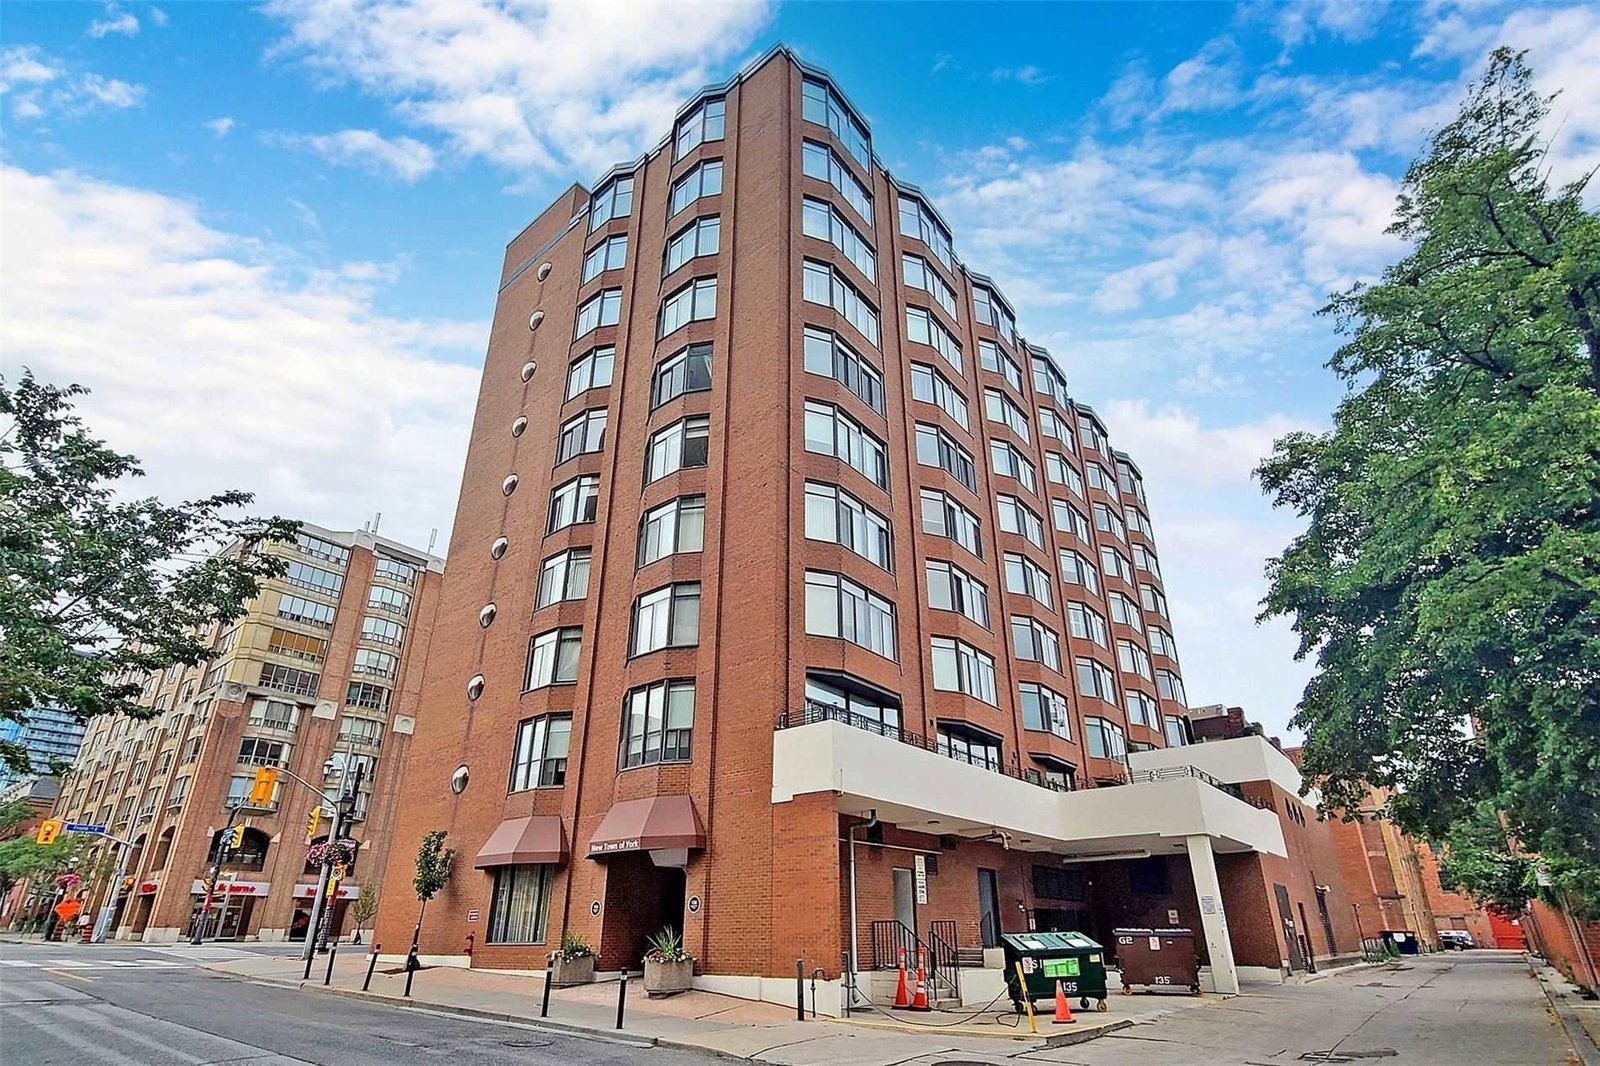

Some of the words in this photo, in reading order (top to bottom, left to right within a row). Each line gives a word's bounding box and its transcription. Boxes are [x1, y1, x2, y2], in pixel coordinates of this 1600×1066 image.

[591, 843, 603, 852] New
[604, 842, 618, 851] Town
[619, 840, 625, 849] of
[626, 839, 640, 848] York
[1118, 936, 1134, 945] G2
[1155, 976, 1171, 985] 135
[1063, 982, 1078, 992] 135
